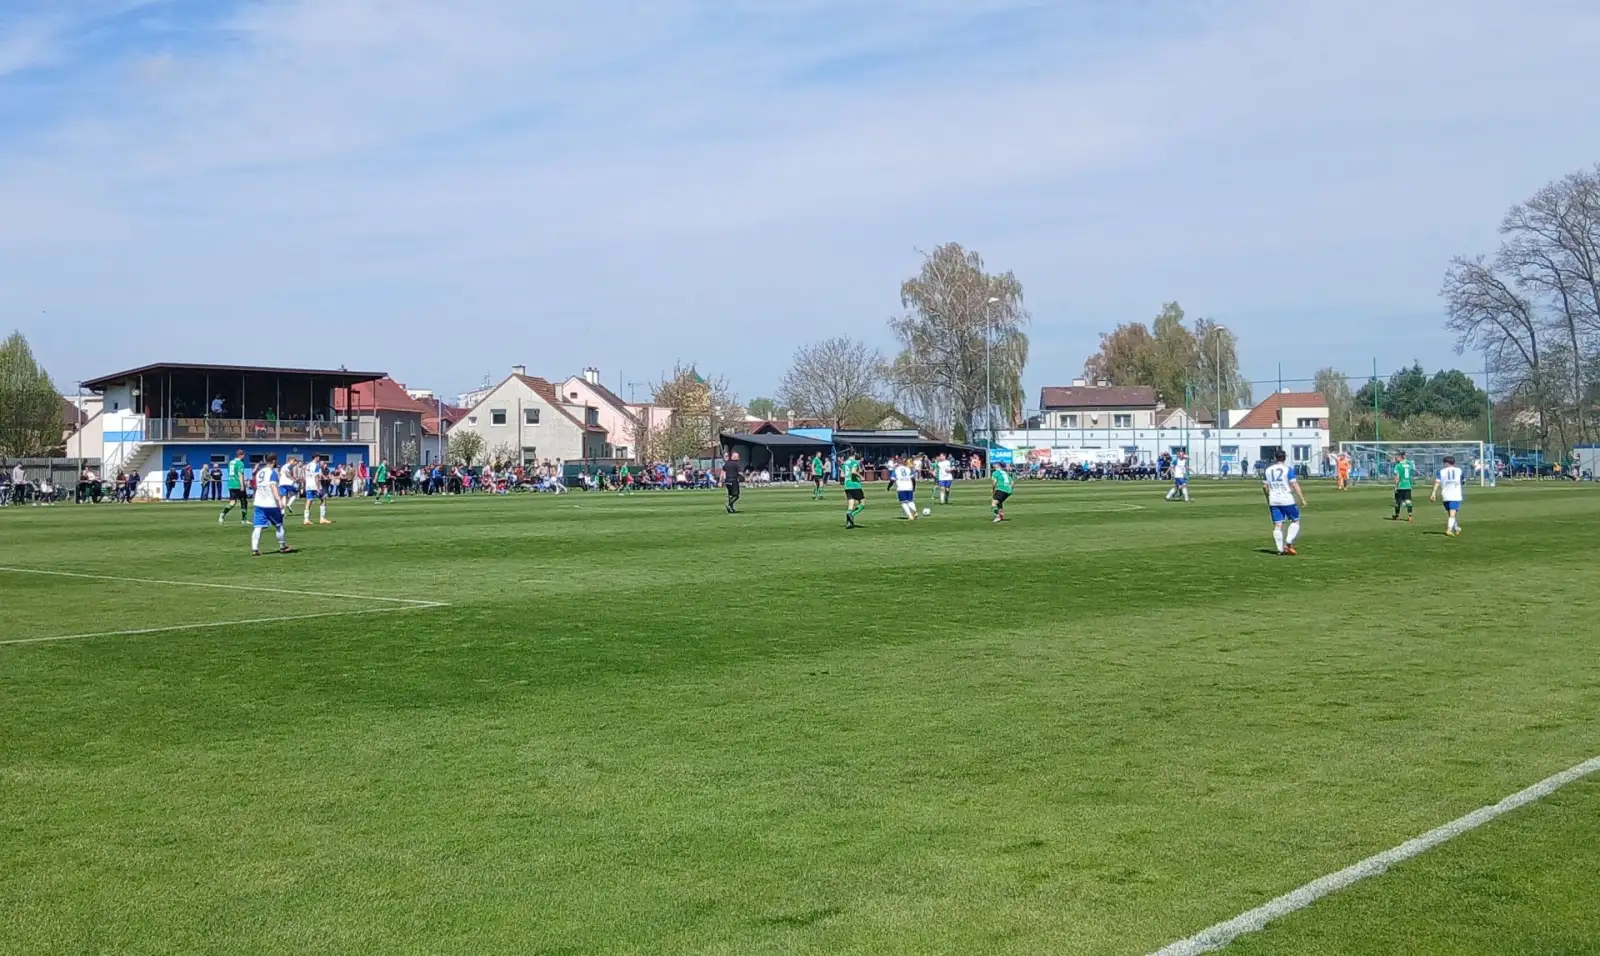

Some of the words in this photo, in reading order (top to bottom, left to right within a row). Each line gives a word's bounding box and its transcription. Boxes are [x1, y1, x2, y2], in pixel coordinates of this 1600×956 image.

[258, 471, 266, 483] 9
[900, 468, 907, 477] 8
[1272, 468, 1283, 482] 12
[1448, 470, 1455, 480] 11
